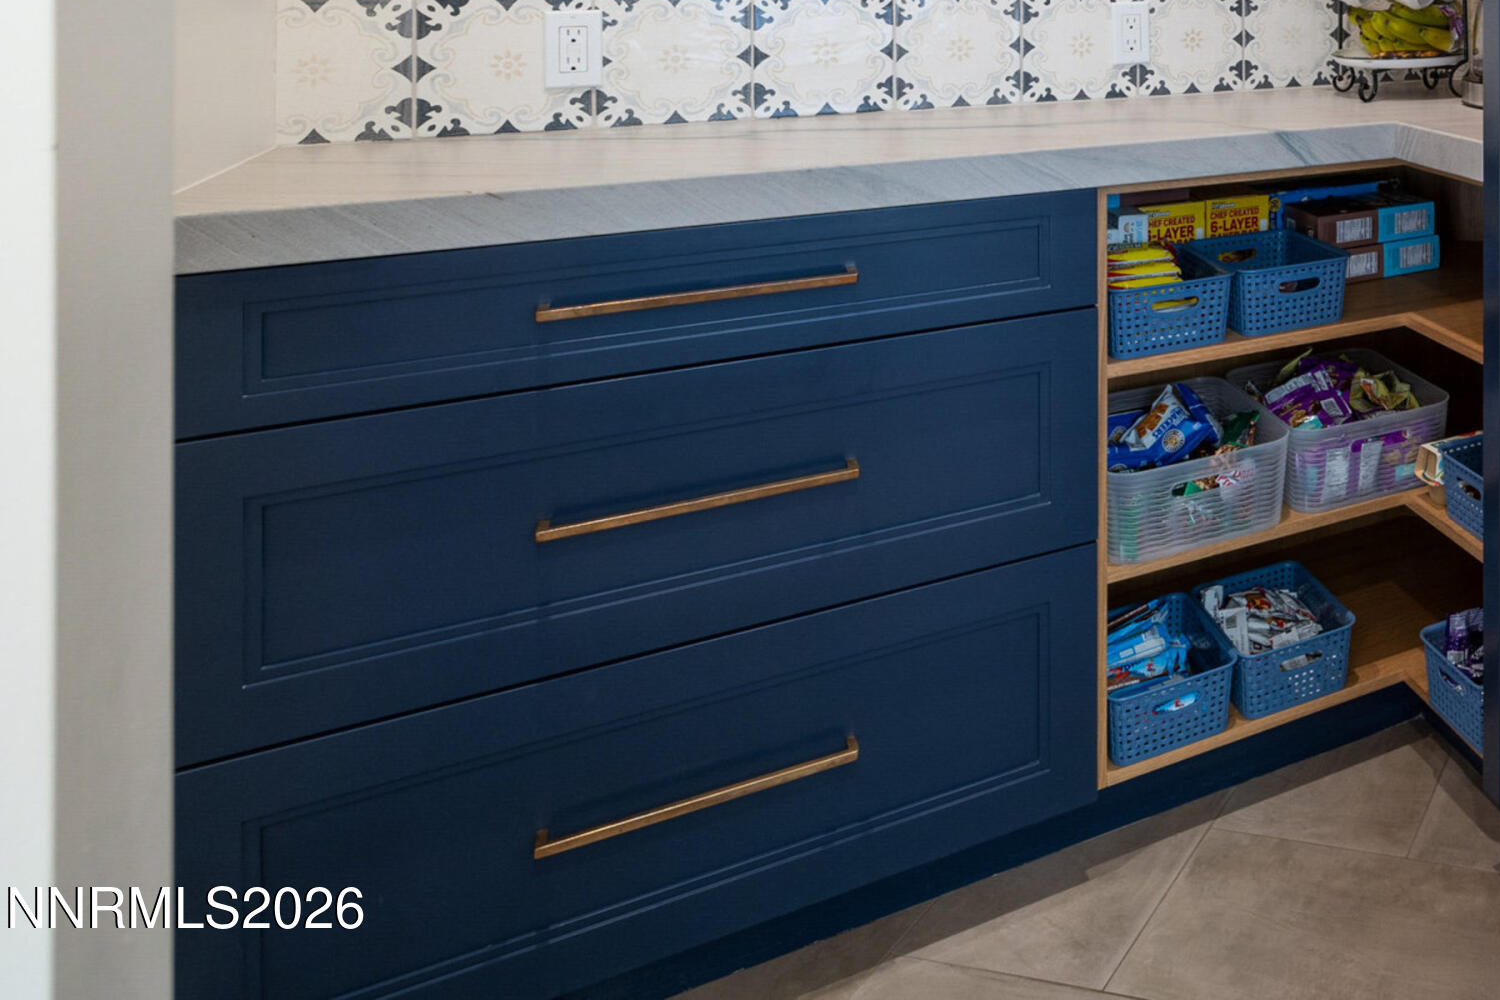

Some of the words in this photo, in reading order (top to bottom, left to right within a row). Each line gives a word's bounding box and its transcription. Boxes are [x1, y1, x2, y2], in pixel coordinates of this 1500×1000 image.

[1209, 208, 1228, 220] CHEF
[1229, 206, 1260, 218] CREATED
[1148, 218, 1163, 228] HEF
[1163, 215, 1196, 226] CREATED
[1210, 216, 1259, 233] 6-LAYER
